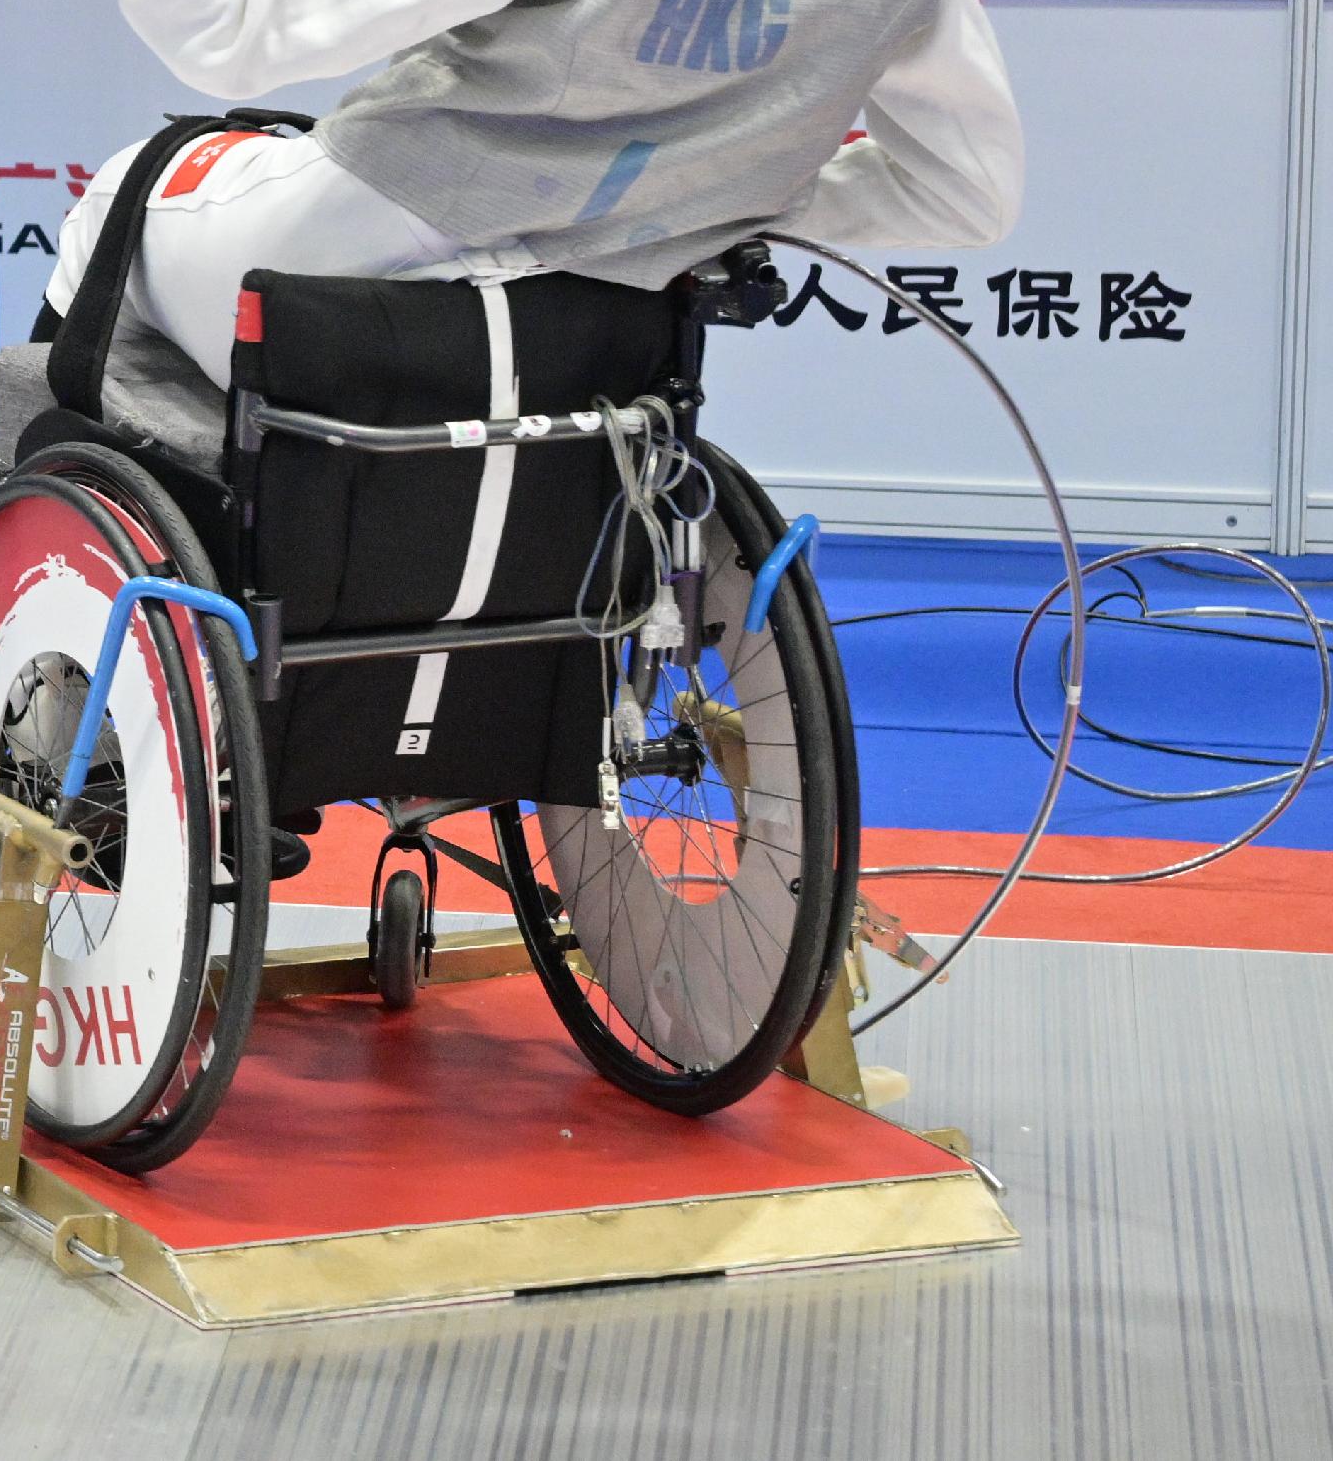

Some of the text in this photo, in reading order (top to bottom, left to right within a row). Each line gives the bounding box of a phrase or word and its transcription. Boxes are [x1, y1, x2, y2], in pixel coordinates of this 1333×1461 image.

[715, 263, 1193, 342] 人民保险
[35, 985, 142, 1068] HKG
